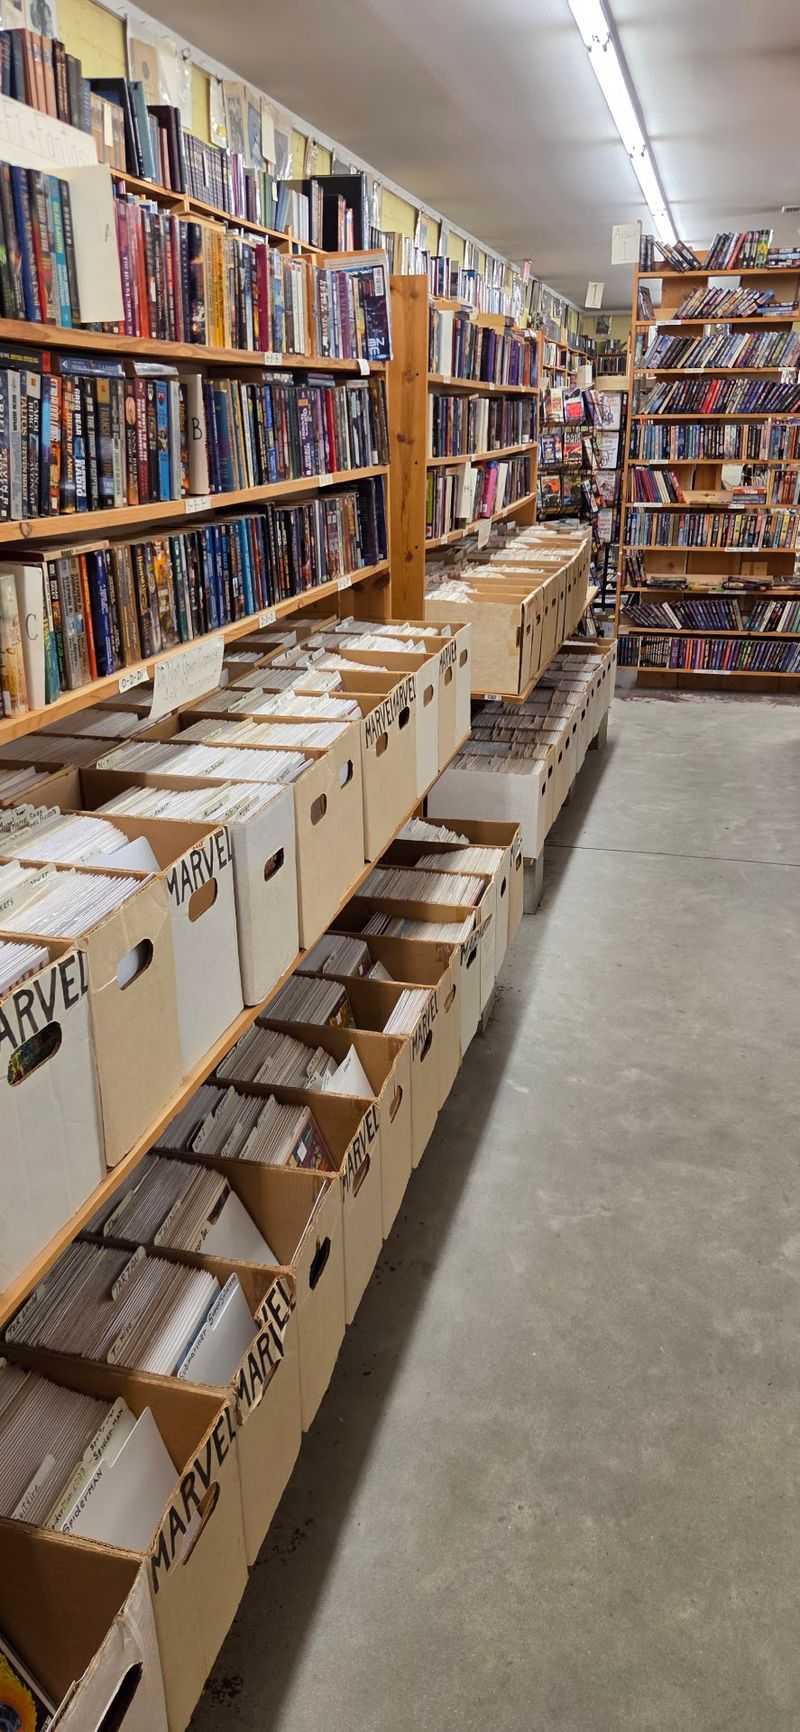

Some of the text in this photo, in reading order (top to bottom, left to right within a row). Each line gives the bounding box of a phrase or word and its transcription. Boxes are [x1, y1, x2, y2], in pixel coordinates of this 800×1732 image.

[74, 413, 82, 436] BEAR
[192, 417, 203, 440] B
[26, 613, 39, 641] C
[439, 639, 457, 673] MARVEL
[393, 676, 416, 717] MARVEL
[365, 697, 395, 749] MARVEL
[166, 825, 233, 906] MARVEL
[411, 990, 439, 1062] MARVEL
[341, 1105, 380, 1205] MARVEL
[150, 1407, 237, 1594] MARVEL
